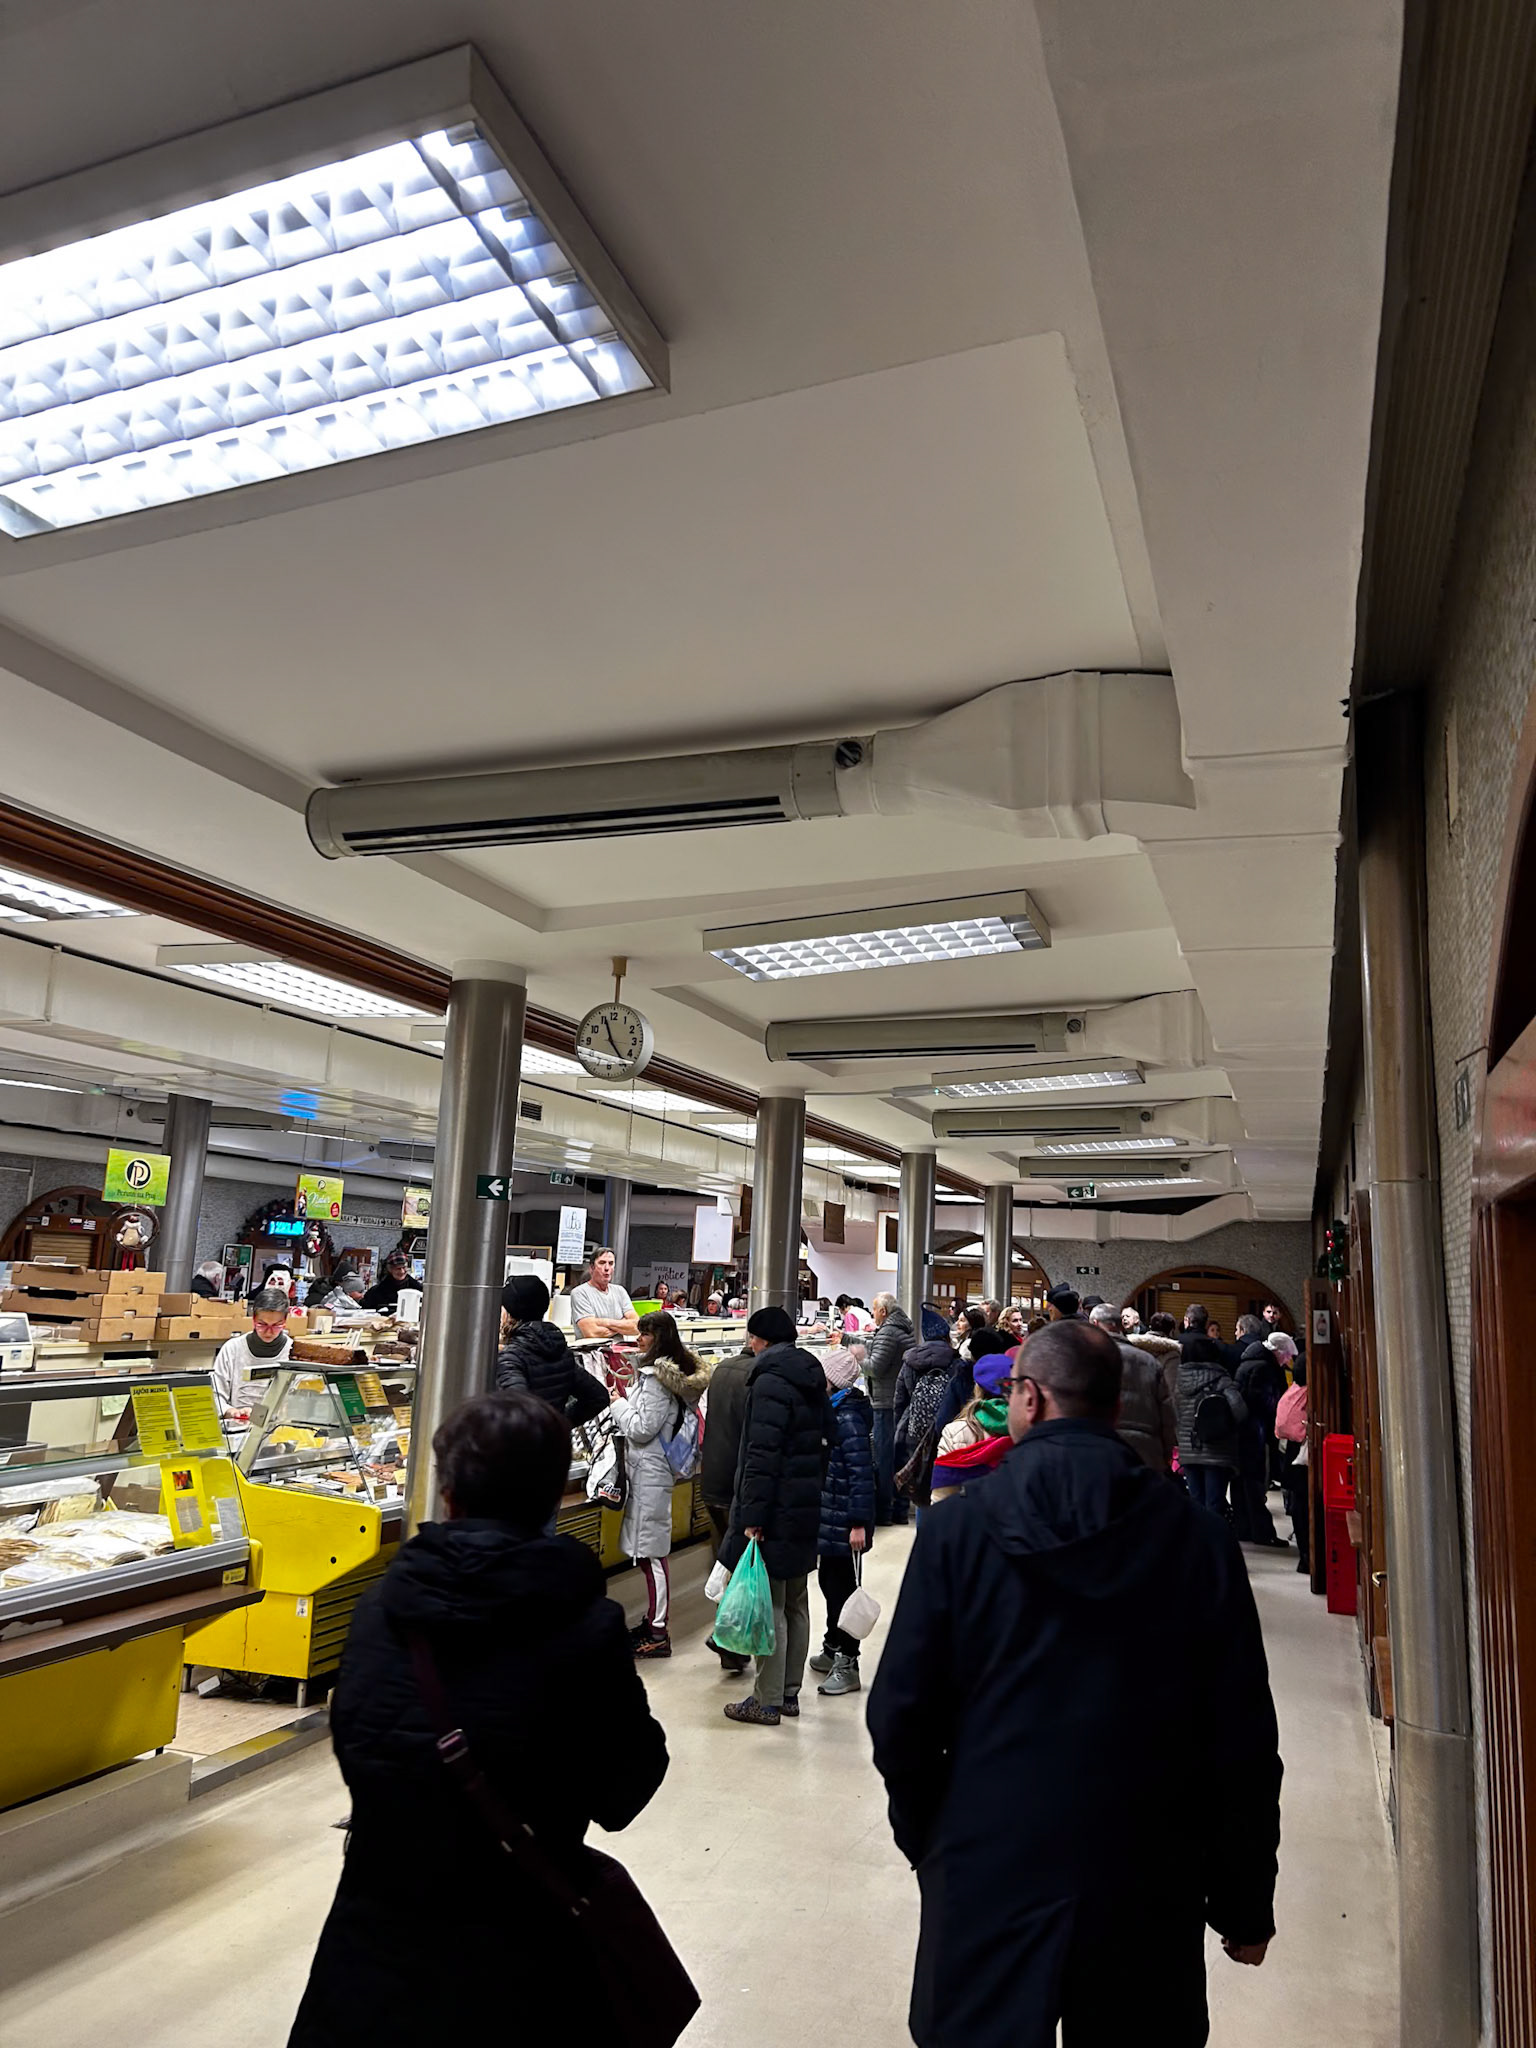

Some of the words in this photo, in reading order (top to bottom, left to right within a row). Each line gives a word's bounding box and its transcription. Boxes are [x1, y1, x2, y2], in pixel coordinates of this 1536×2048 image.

[610, 1012, 618, 1020] 12
[624, 1016, 627, 1024] 1
[591, 1025, 599, 1034] 10
[629, 1025, 635, 1034] 2
[586, 1037, 592, 1045] 9
[631, 1037, 637, 1046] 3
[627, 1049, 633, 1057] 4
[604, 1484, 620, 1496] dm
